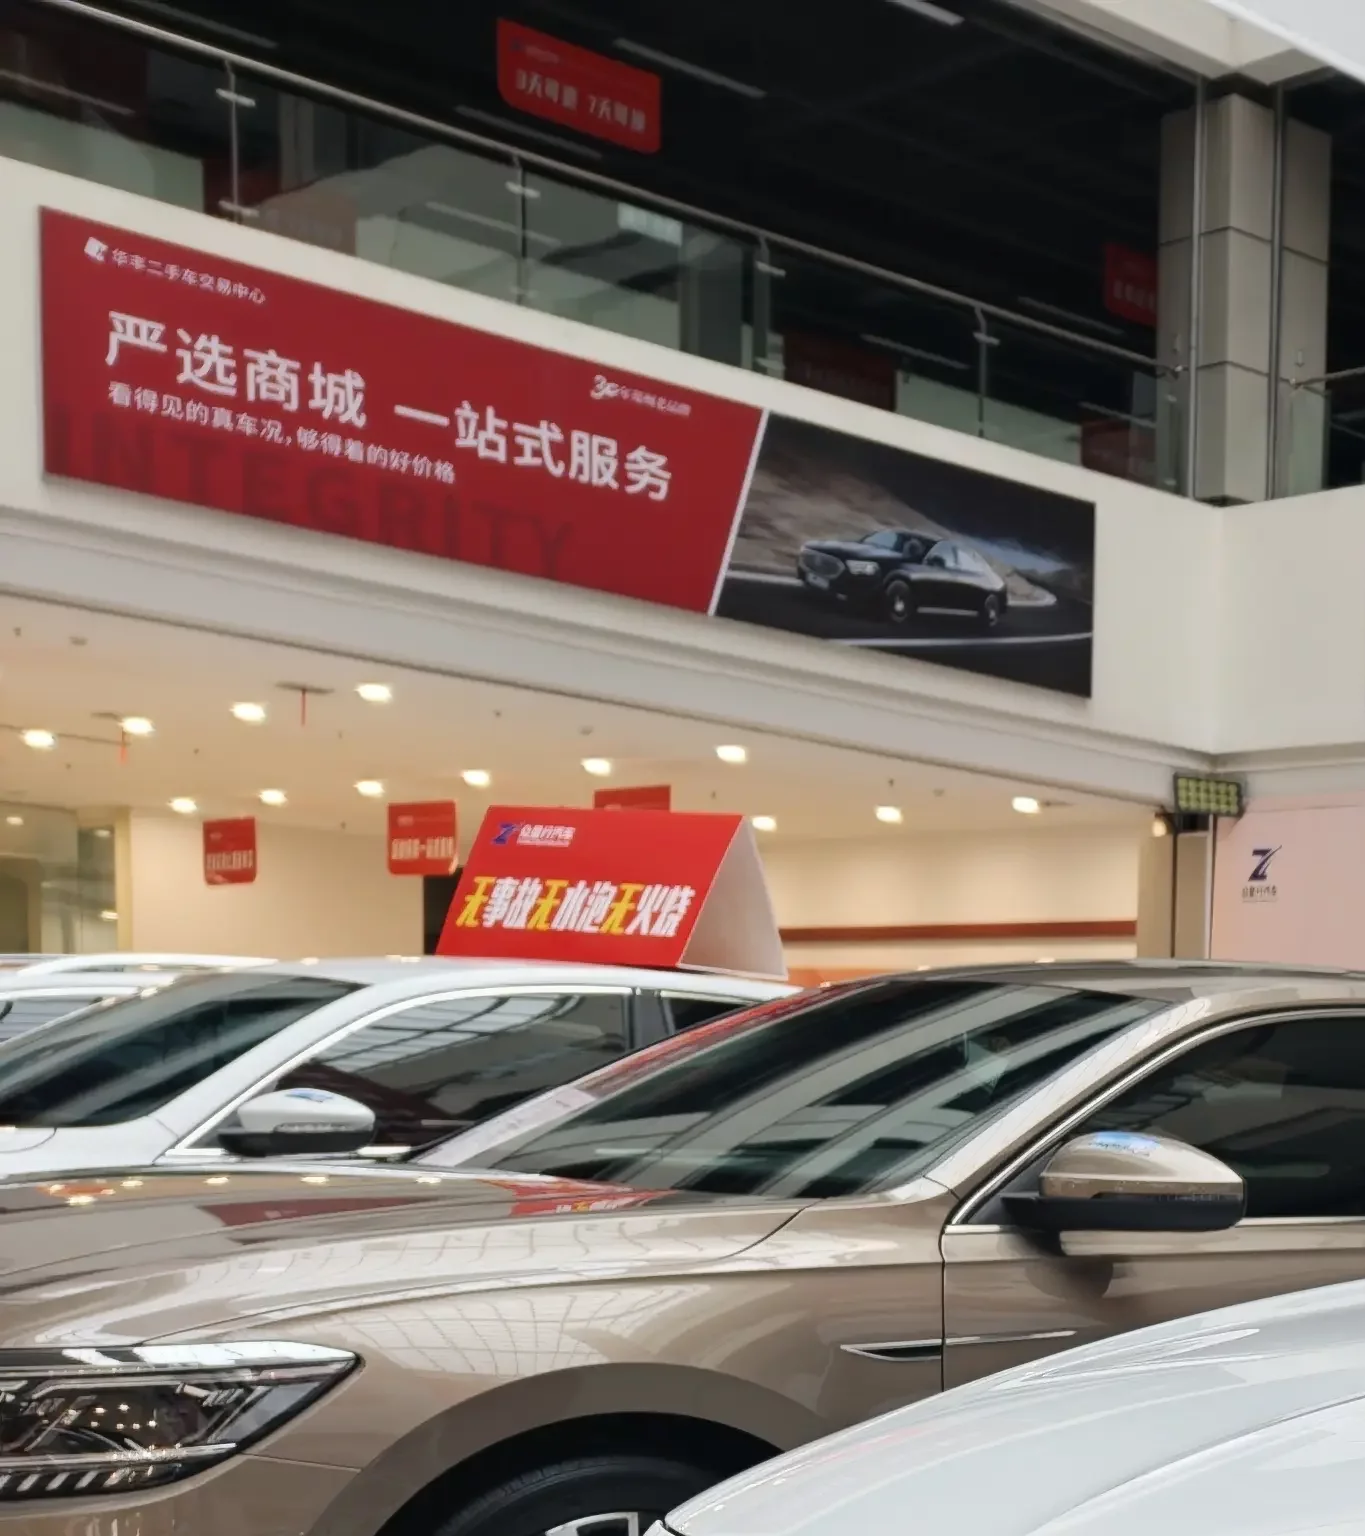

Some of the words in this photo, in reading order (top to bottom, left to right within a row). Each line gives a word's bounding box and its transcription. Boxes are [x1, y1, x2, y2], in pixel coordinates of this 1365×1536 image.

[104, 310, 368, 430] 严选商城
[393, 398, 673, 502] 一站式服务
[455, 875, 696, 938] 无事故无水泡无火烧
